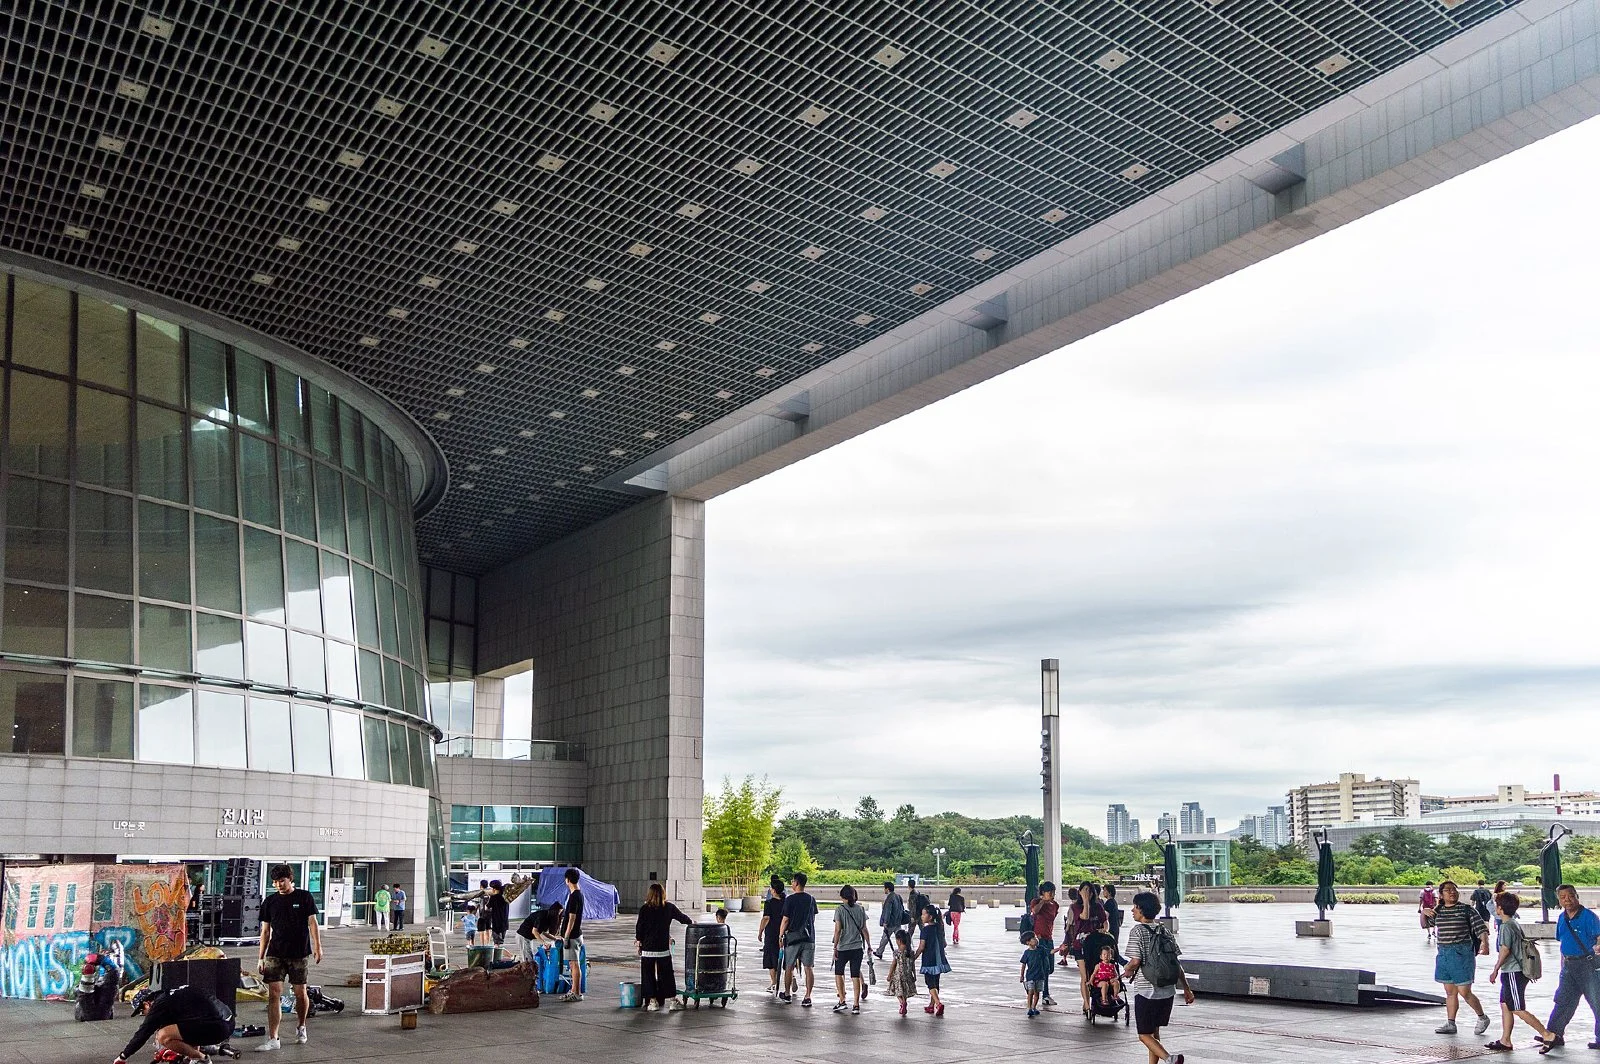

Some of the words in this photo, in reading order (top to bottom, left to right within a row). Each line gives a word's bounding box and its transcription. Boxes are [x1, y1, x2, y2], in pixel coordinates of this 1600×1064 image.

[222, 808, 264, 825] 전시관
[216, 829, 255, 839] Exhibition
[255, 829, 269, 839] Hal
[0, 926, 144, 998] MONSTR
